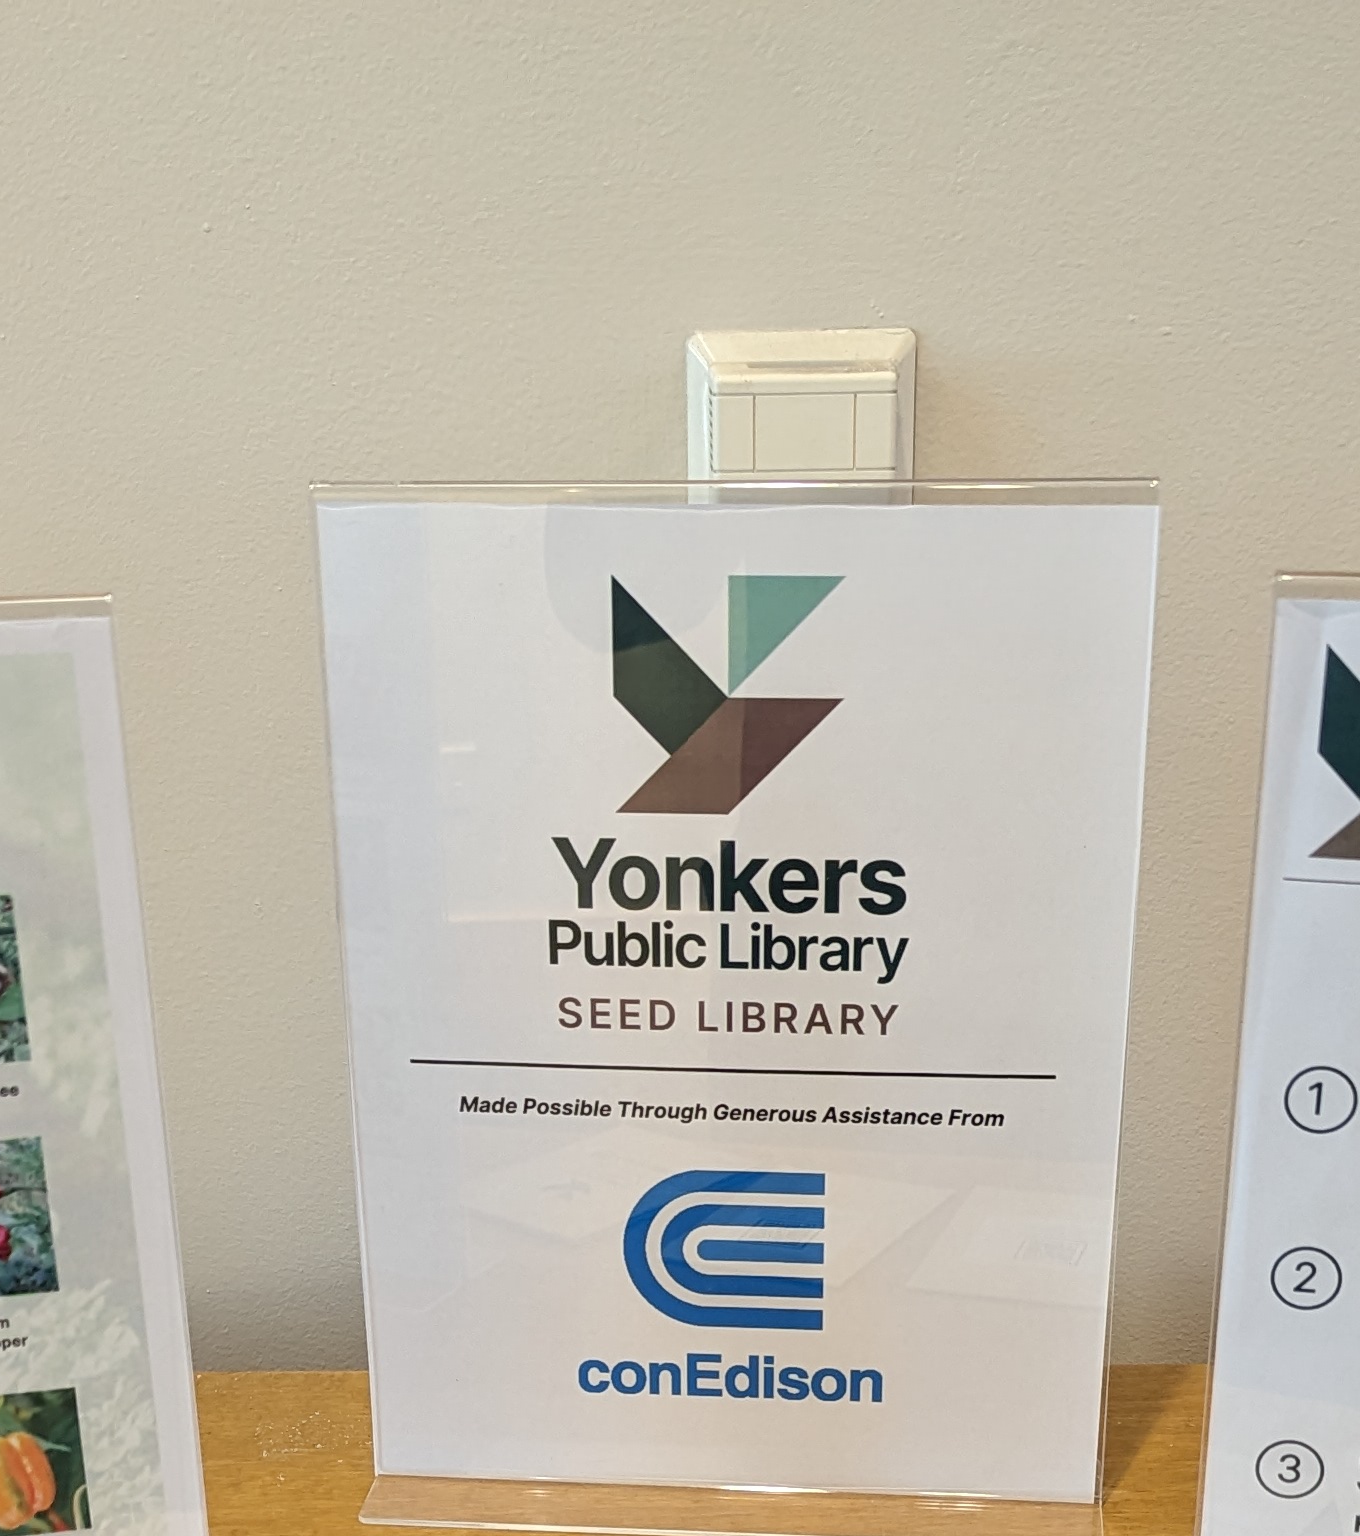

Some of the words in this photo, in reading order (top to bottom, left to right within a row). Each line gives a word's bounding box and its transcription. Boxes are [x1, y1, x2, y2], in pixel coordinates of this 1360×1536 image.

[551, 836, 907, 916] Yonkers
[548, 919, 707, 969] Public
[720, 921, 910, 985] Library
[558, 996, 676, 1031] SEED
[698, 1000, 899, 1036] LIBRARY
[459, 1095, 518, 1114] Made
[522, 1097, 612, 1117] Possible
[618, 1100, 707, 1124] Through
[713, 1103, 818, 1123] Generous
[821, 1106, 943, 1126] Assistance
[947, 1109, 1005, 1127] From
[578, 1352, 883, 1403] conEdison
